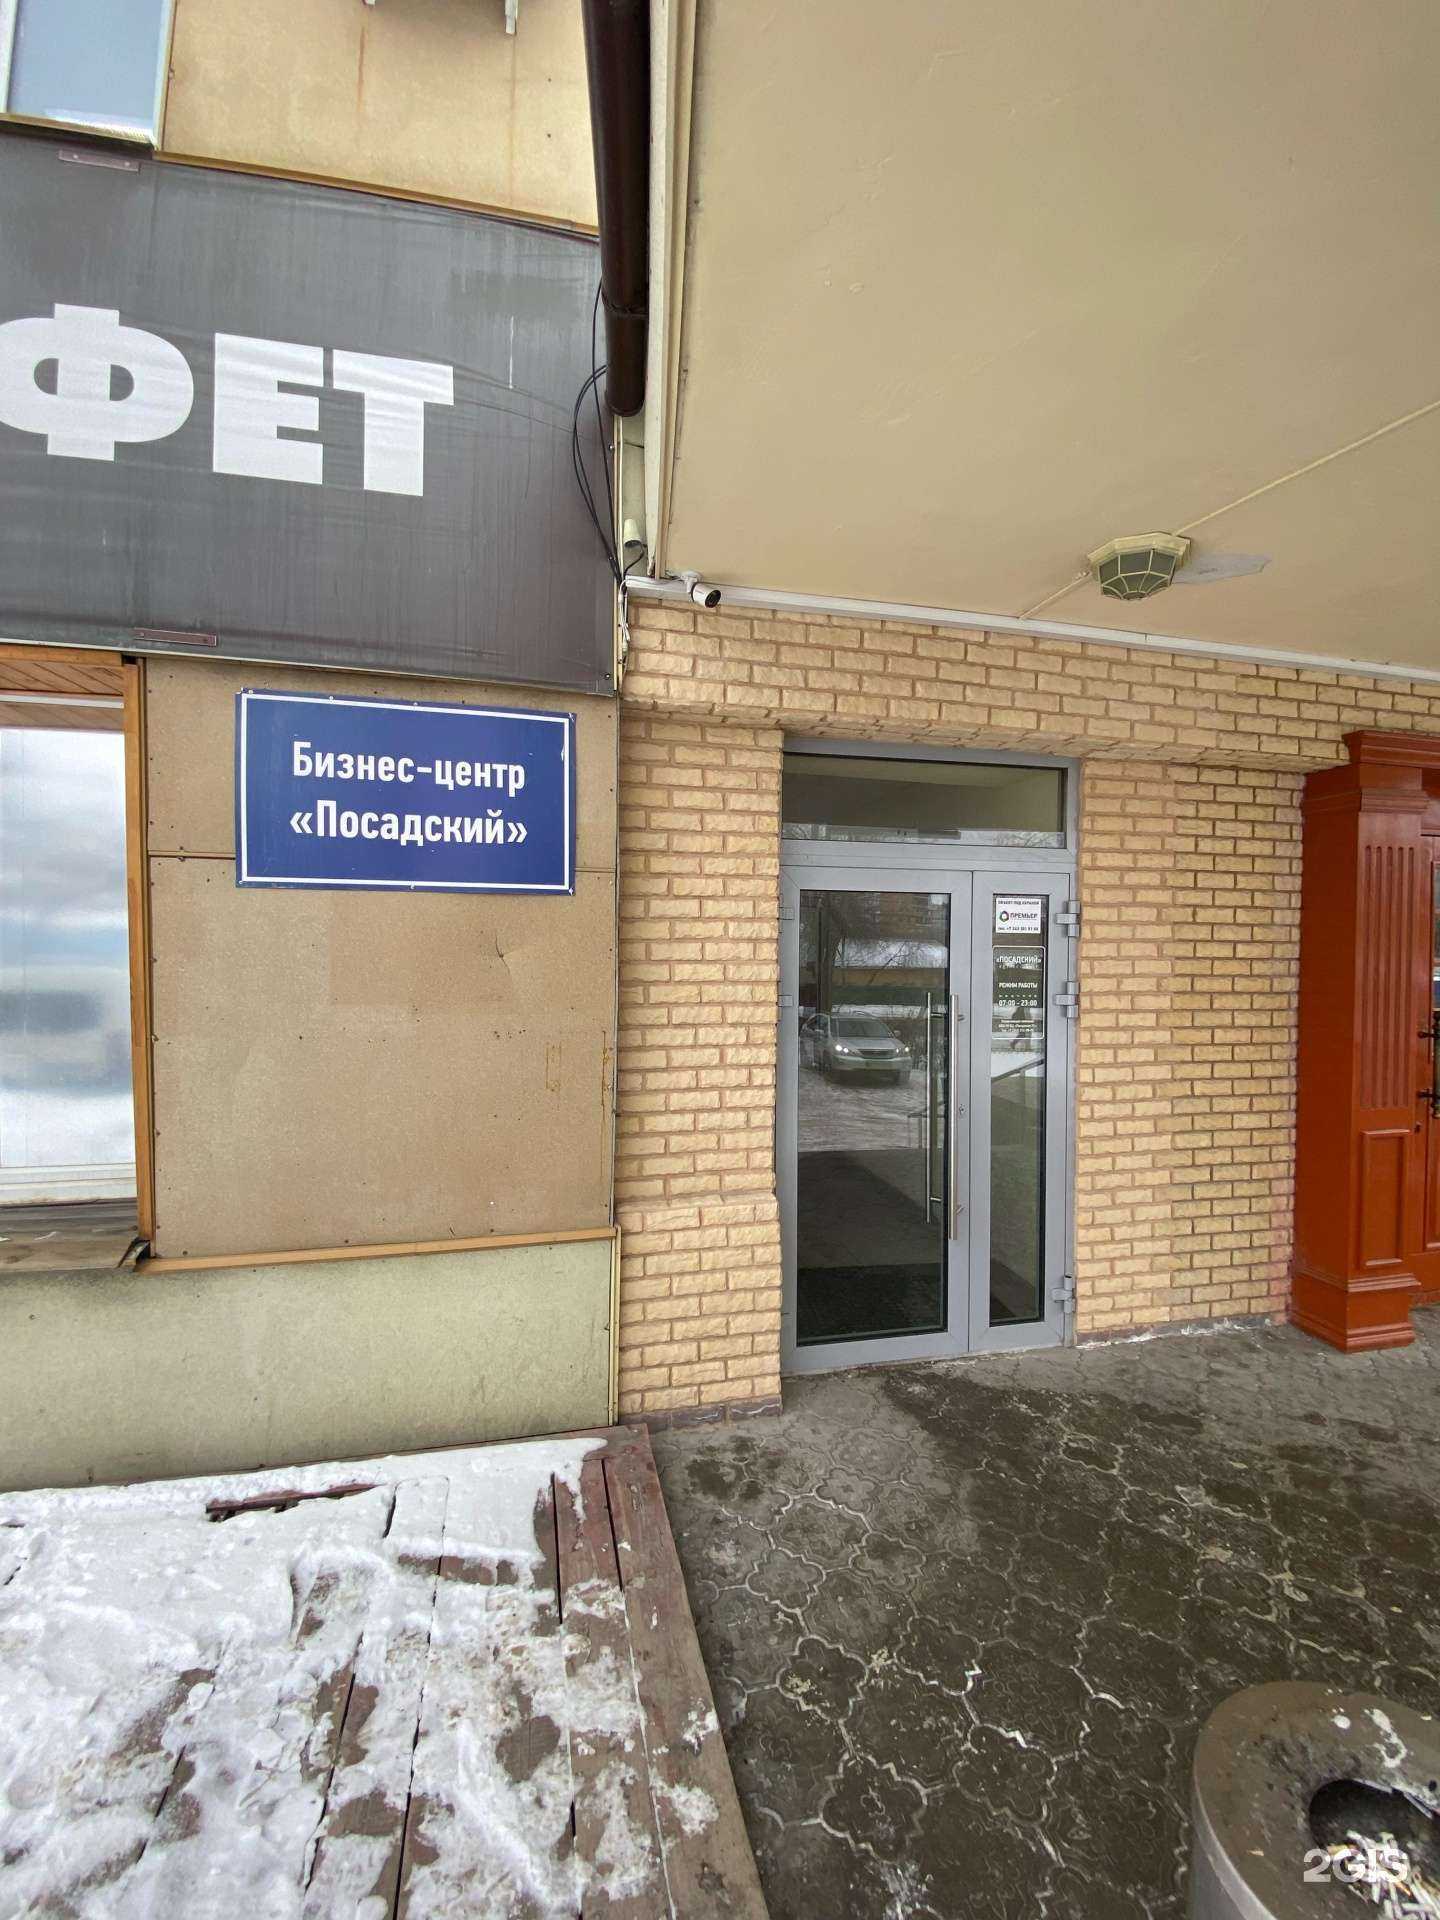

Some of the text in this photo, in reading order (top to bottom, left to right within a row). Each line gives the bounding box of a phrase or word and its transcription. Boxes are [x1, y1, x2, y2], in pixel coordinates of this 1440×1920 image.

[0, 303, 454, 496] ФЕТ
[292, 741, 526, 798] Бизнес-центр
[289, 799, 528, 847] «Посадский»
[996, 955, 1041, 965] «ПОСАДСКИЙ»
